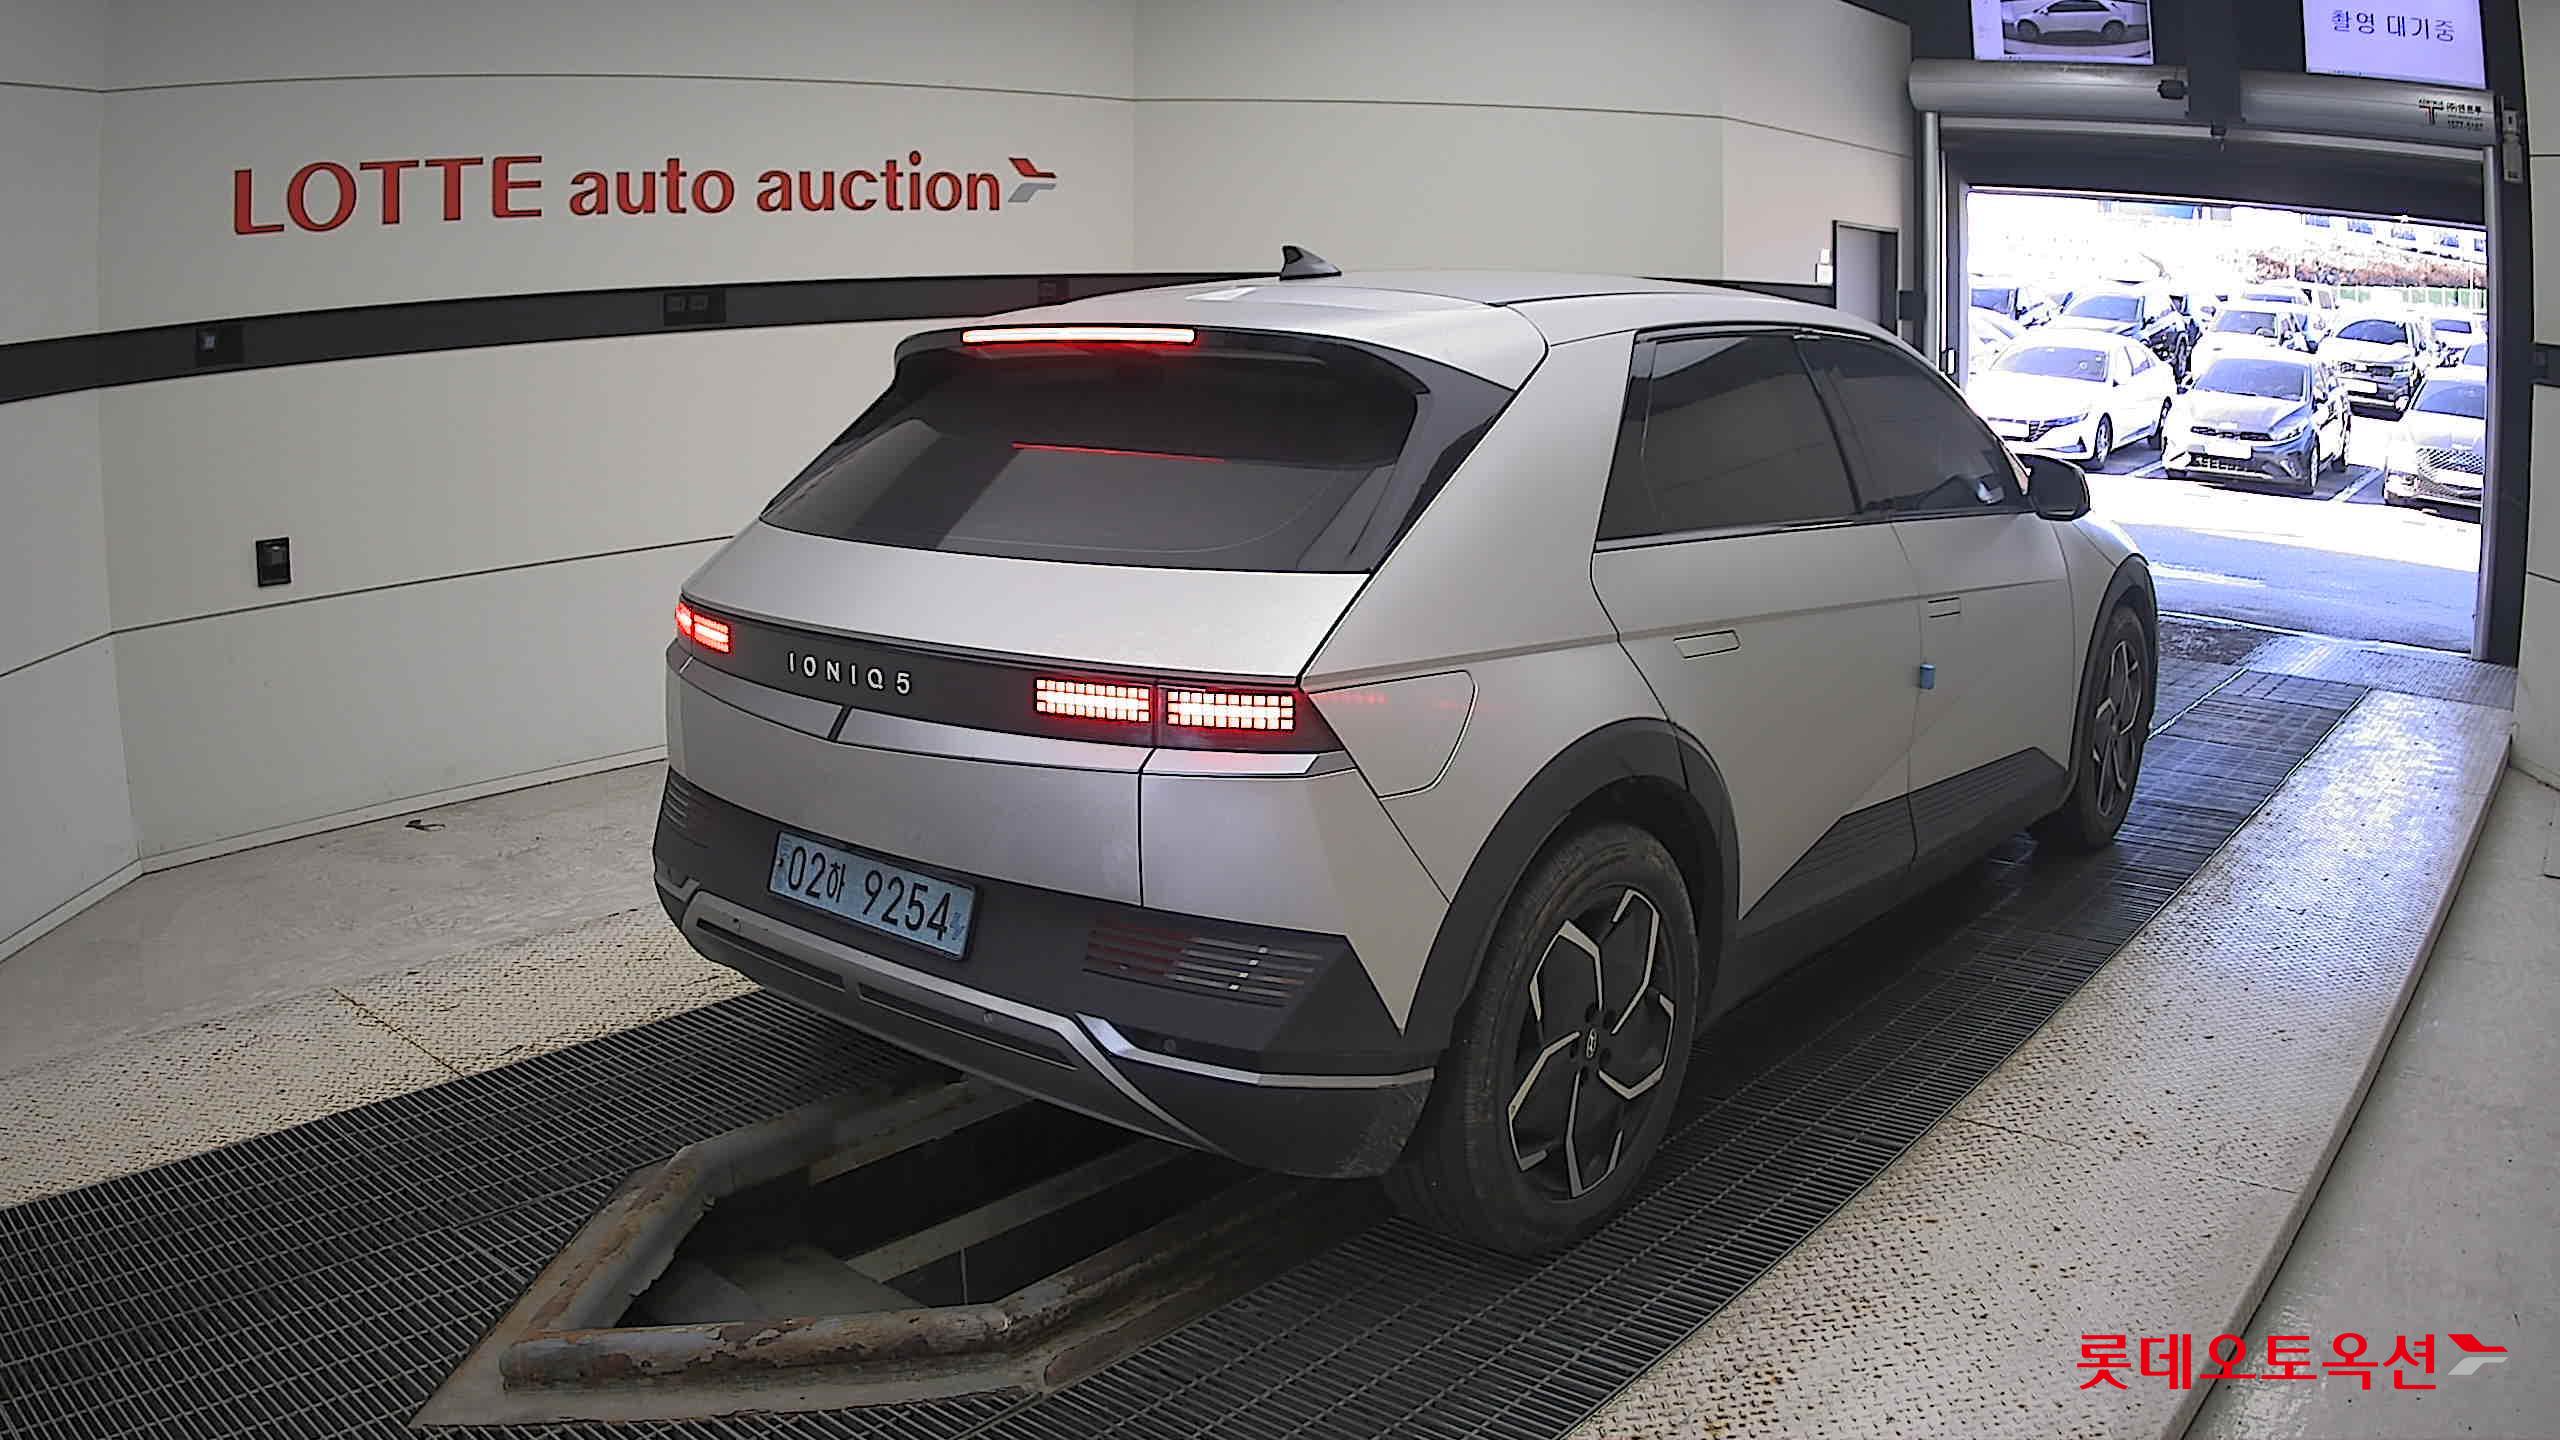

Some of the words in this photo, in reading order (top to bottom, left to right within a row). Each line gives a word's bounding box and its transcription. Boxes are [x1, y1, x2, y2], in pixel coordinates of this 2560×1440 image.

[2331, 9, 2376, 34] 촬영
[2386, 15, 2455, 42] 대기중
[233, 154, 544, 235] LOTTE
[568, 156, 736, 216] auto
[756, 150, 1002, 213] auction
[787, 651, 885, 691] IONIQ
[896, 671, 911, 695] 5
[787, 845, 847, 903] 02하
[862, 869, 952, 941] 9254
